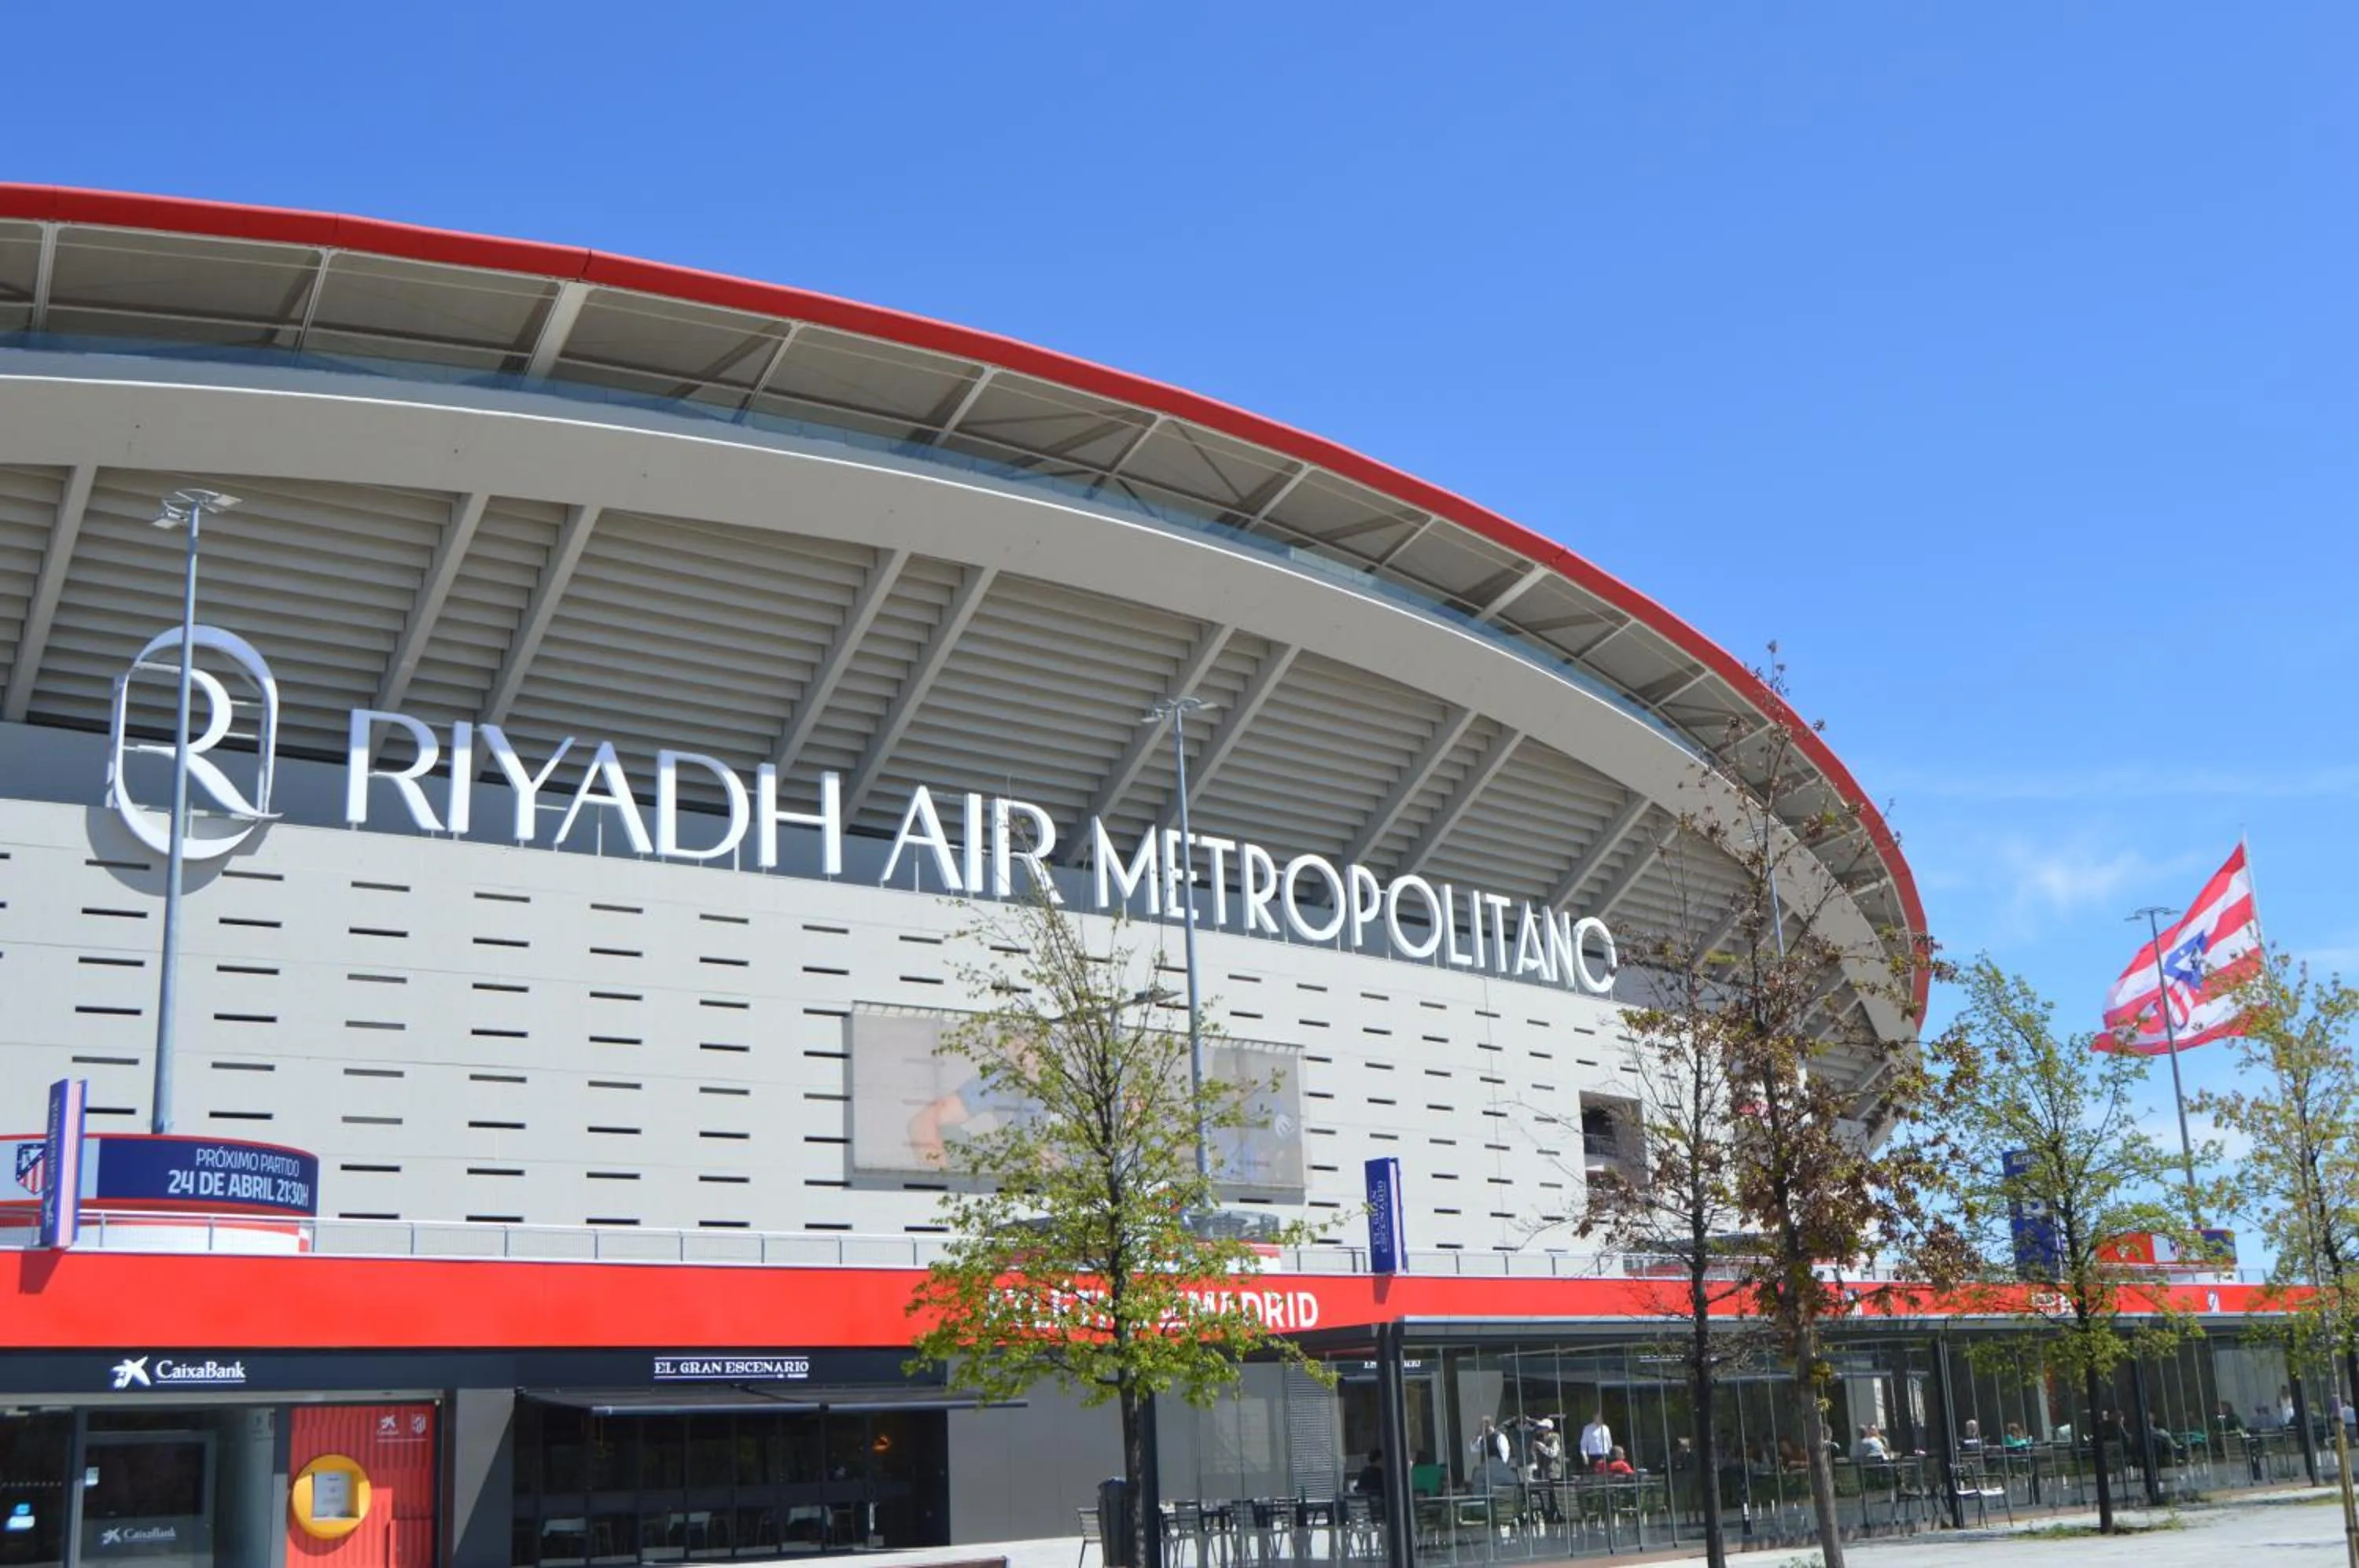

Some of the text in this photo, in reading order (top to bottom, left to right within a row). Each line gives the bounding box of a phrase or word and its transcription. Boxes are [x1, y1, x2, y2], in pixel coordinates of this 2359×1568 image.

[346, 709, 1618, 993] RIYADH AIR METROPOLITANO
[196, 1146, 300, 1177] PRÓXIMO PARTIDO
[167, 1169, 194, 1194] 24
[199, 1171, 225, 1196] DE
[227, 1174, 275, 1202] ABRIL
[155, 1360, 246, 1379] CaixaBank
[654, 1361, 809, 1374] EL GRAN ESCENARIO
